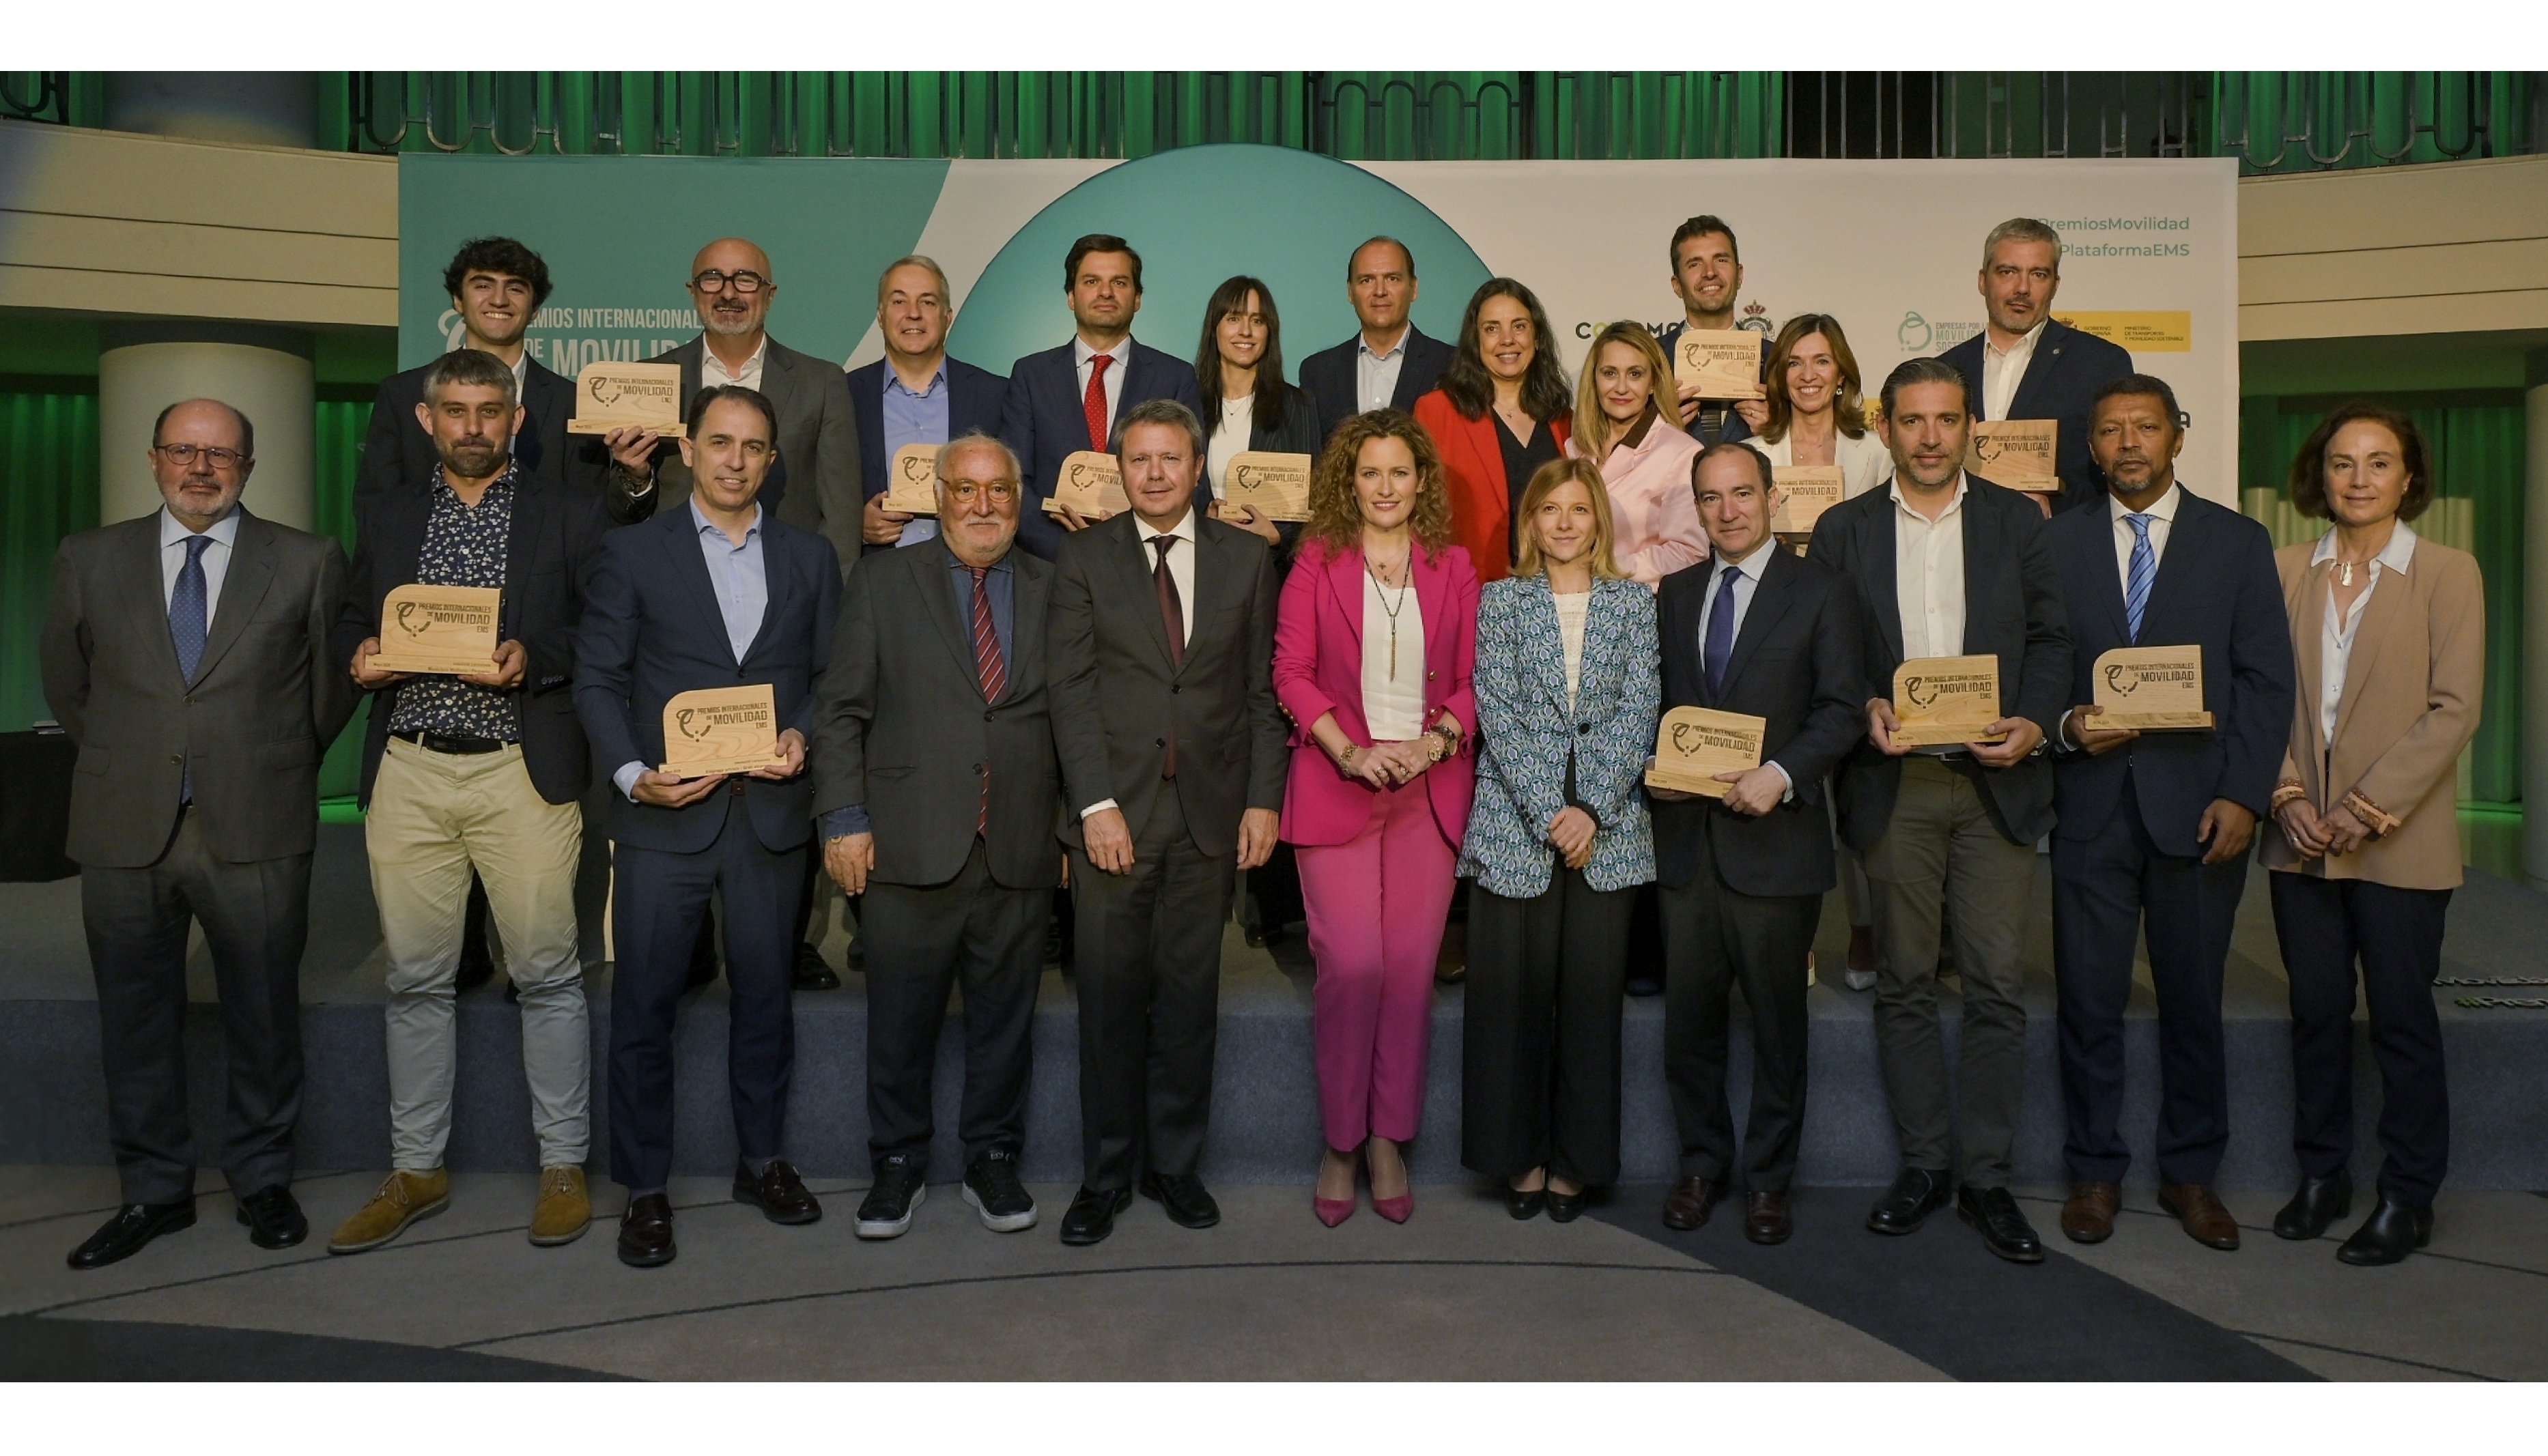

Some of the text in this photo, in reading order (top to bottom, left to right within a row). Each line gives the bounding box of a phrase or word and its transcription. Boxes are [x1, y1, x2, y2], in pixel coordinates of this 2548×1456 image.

[2061, 244, 2190, 257] PlataformaEMS
[578, 308, 705, 329] INTERNACIONAL
[1713, 352, 1755, 360] MOVILIDAD
[623, 386, 673, 396] MOVILIDAD
[2004, 442, 2049, 451] MOVILIDAD
[1264, 474, 1304, 482] MOVILIDAD
[444, 604, 492, 613] INTERNACIONALES
[434, 612, 490, 625] MOVILIDAD
[2140, 671, 2194, 682] MOVILIDAD
[1940, 683, 1991, 694] MOVILIDAD
[697, 702, 767, 715] PREMIOS INTERNACIONALES
[713, 711, 767, 725] MOVILIDAD
[1705, 736, 1755, 752] MOVILIDAD
